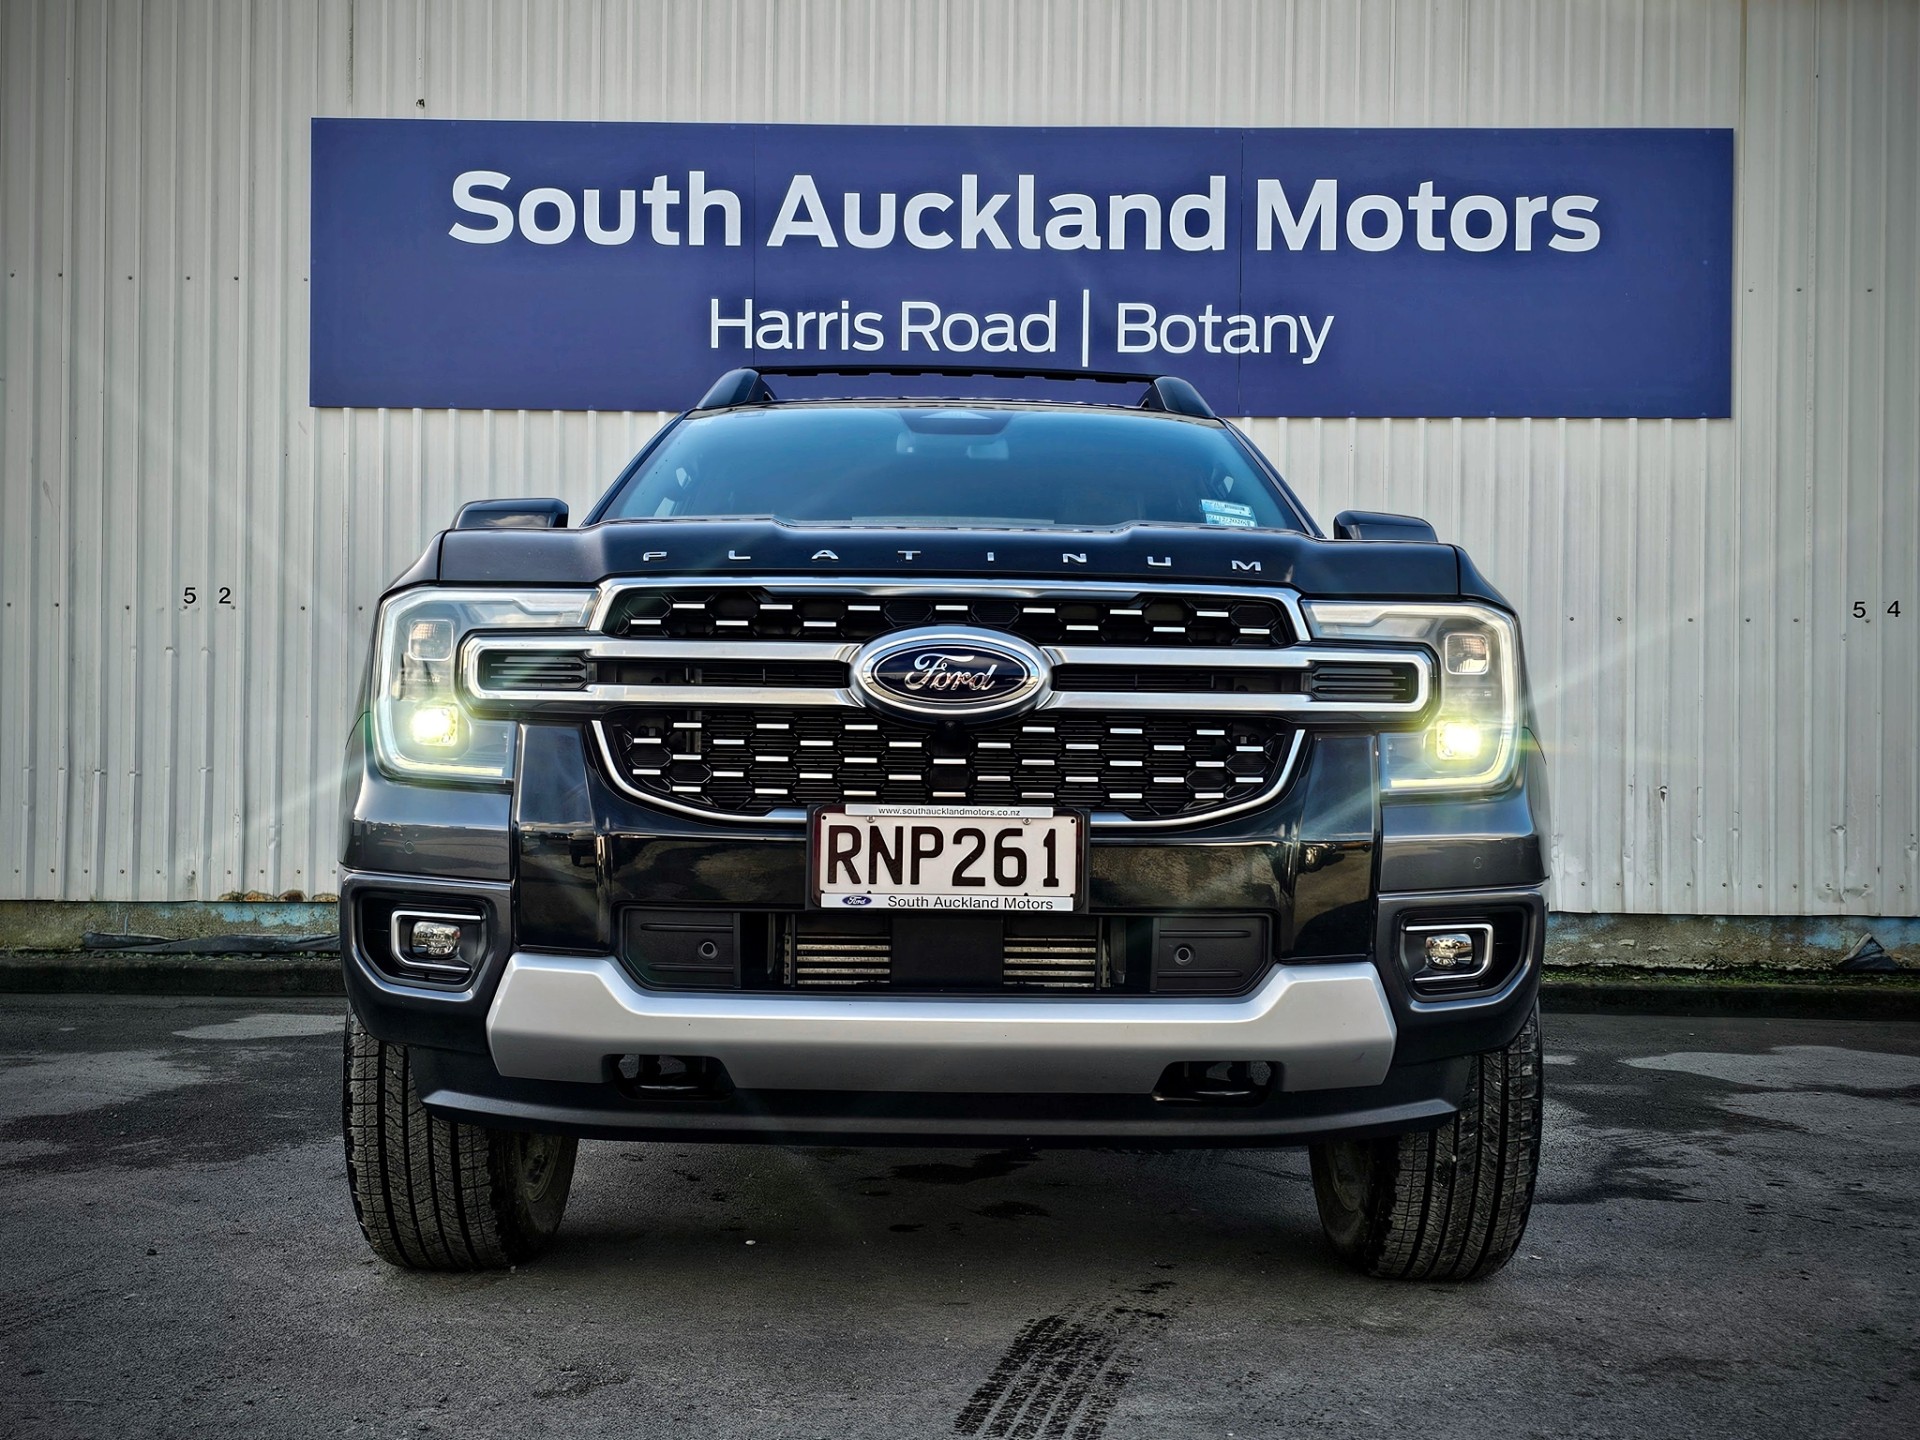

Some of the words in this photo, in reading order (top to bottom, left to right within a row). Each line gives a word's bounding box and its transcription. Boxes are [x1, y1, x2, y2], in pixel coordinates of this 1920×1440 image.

[448, 170, 741, 246] South
[766, 174, 1226, 251] Auckland
[1256, 179, 1601, 252] Motors
[710, 298, 885, 352] Harris
[901, 299, 1057, 353] Road
[1117, 302, 1335, 365] Botany
[642, 549, 1262, 572] PLATINUM
[904, 653, 998, 691] Ford
[878, 806, 1021, 817] www.southaucklandmotors.co.nz
[827, 824, 1060, 887] RNP261
[887, 895, 929, 908] South
[933, 896, 1000, 909] Auckland
[1003, 897, 1054, 910] Motors
